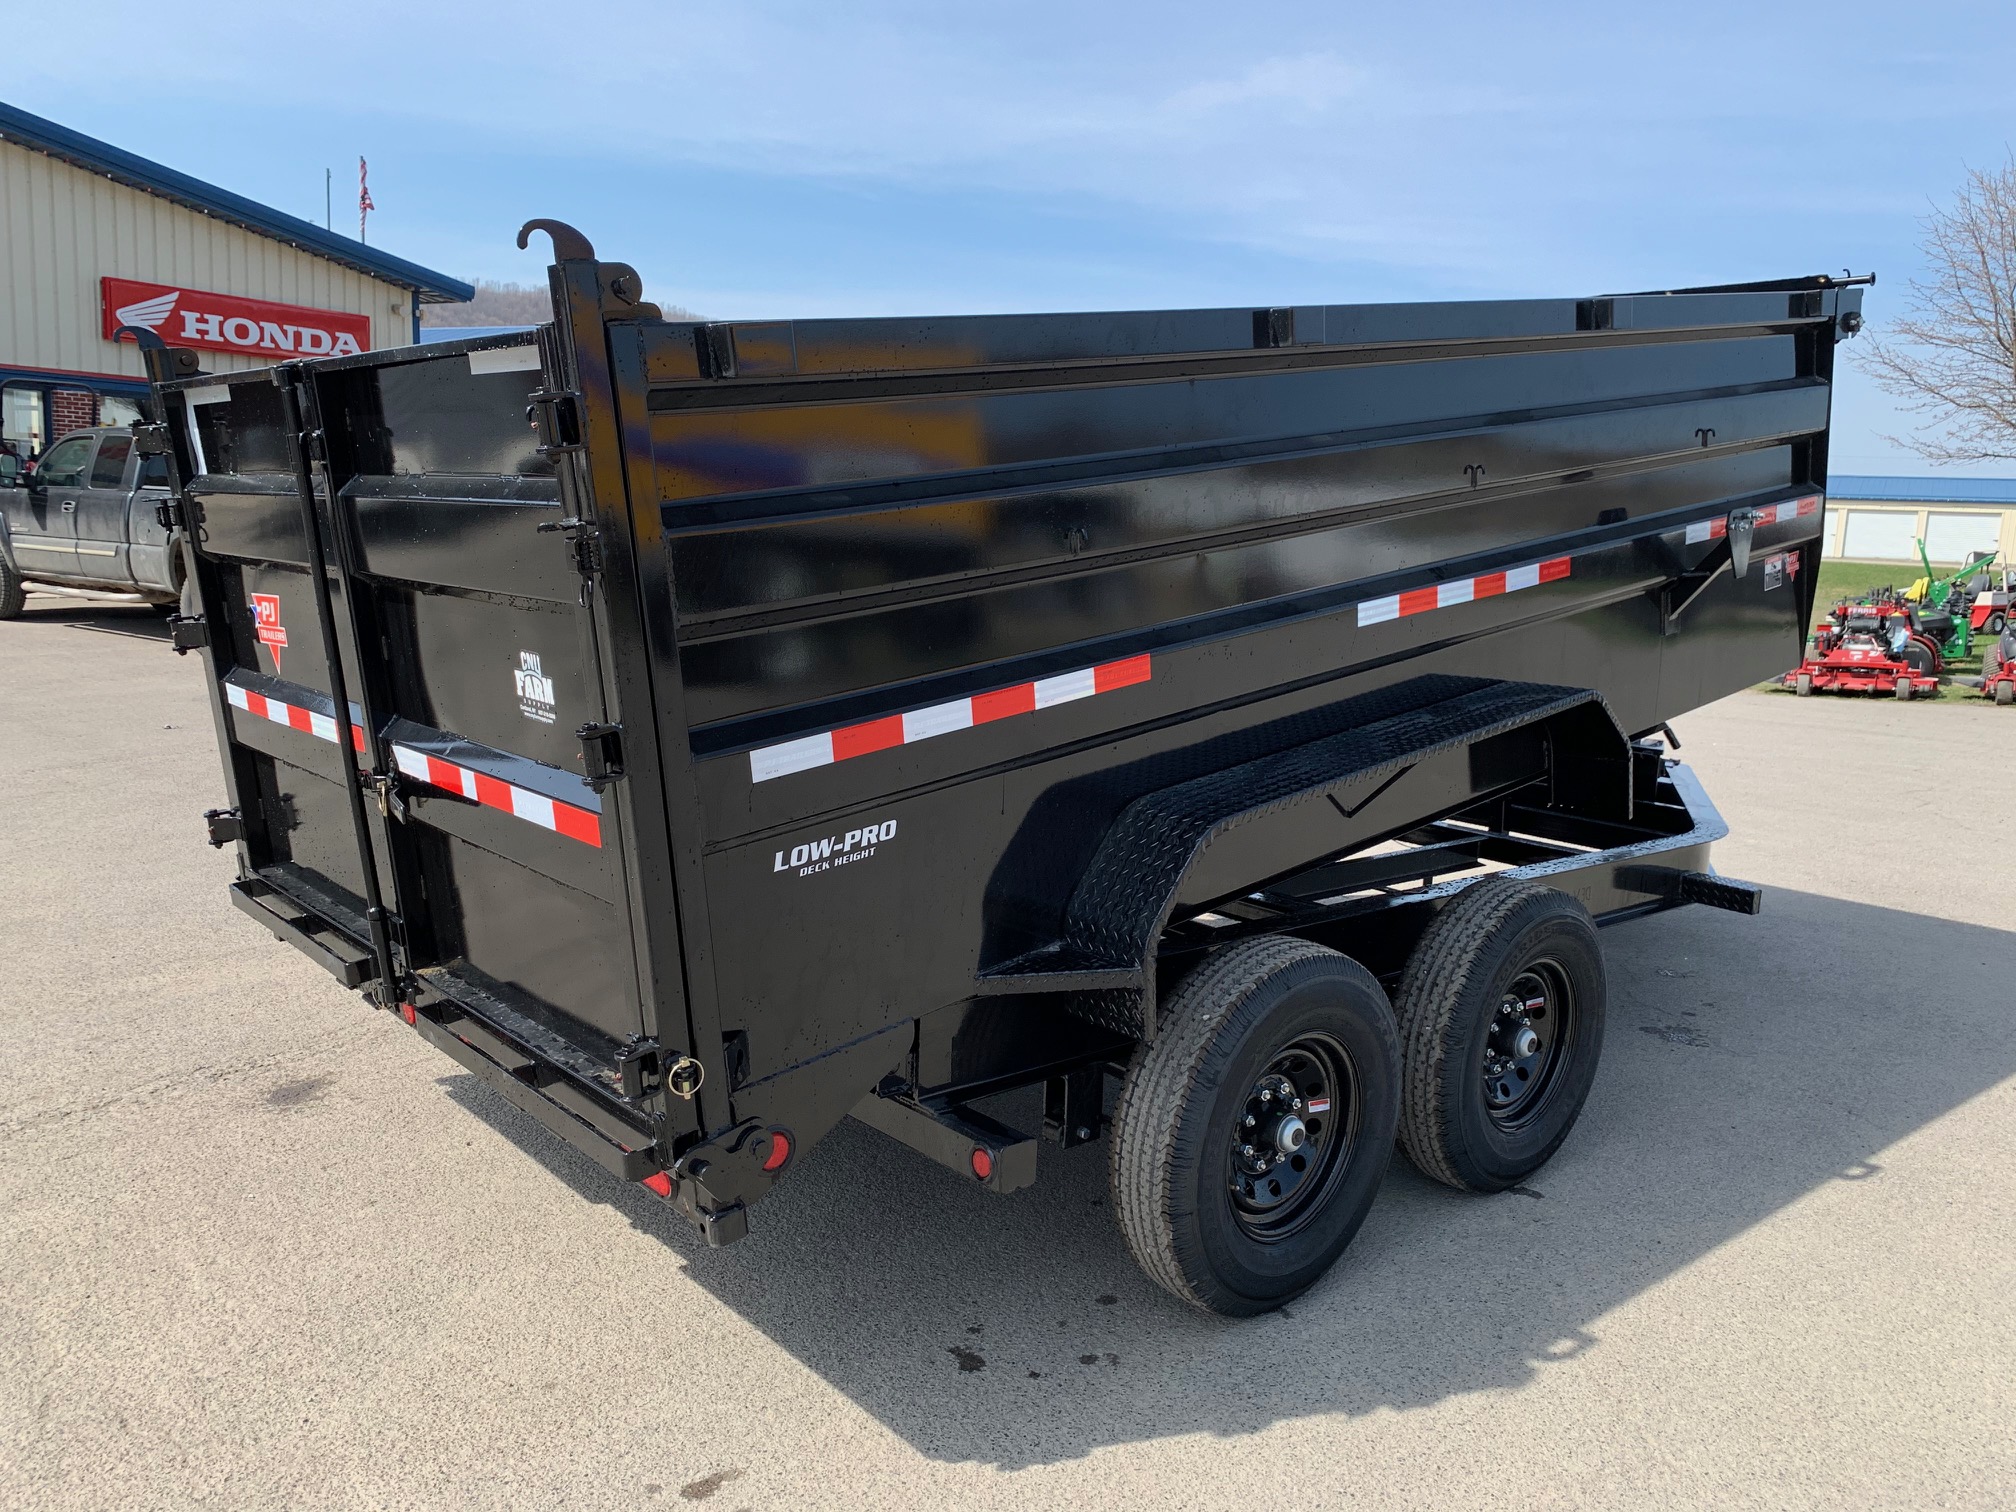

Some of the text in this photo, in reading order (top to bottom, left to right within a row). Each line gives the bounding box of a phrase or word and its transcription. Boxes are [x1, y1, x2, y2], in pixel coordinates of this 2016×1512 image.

[180, 310, 362, 356] HONDA
[261, 601, 276, 622] PJ
[1847, 606, 1878, 614] FERRIS
[260, 629, 286, 642] TRAILERS
[514, 669, 555, 706] FARM
[773, 819, 897, 872] LOW-PRO
[800, 847, 877, 877] DECK HEIGHT
